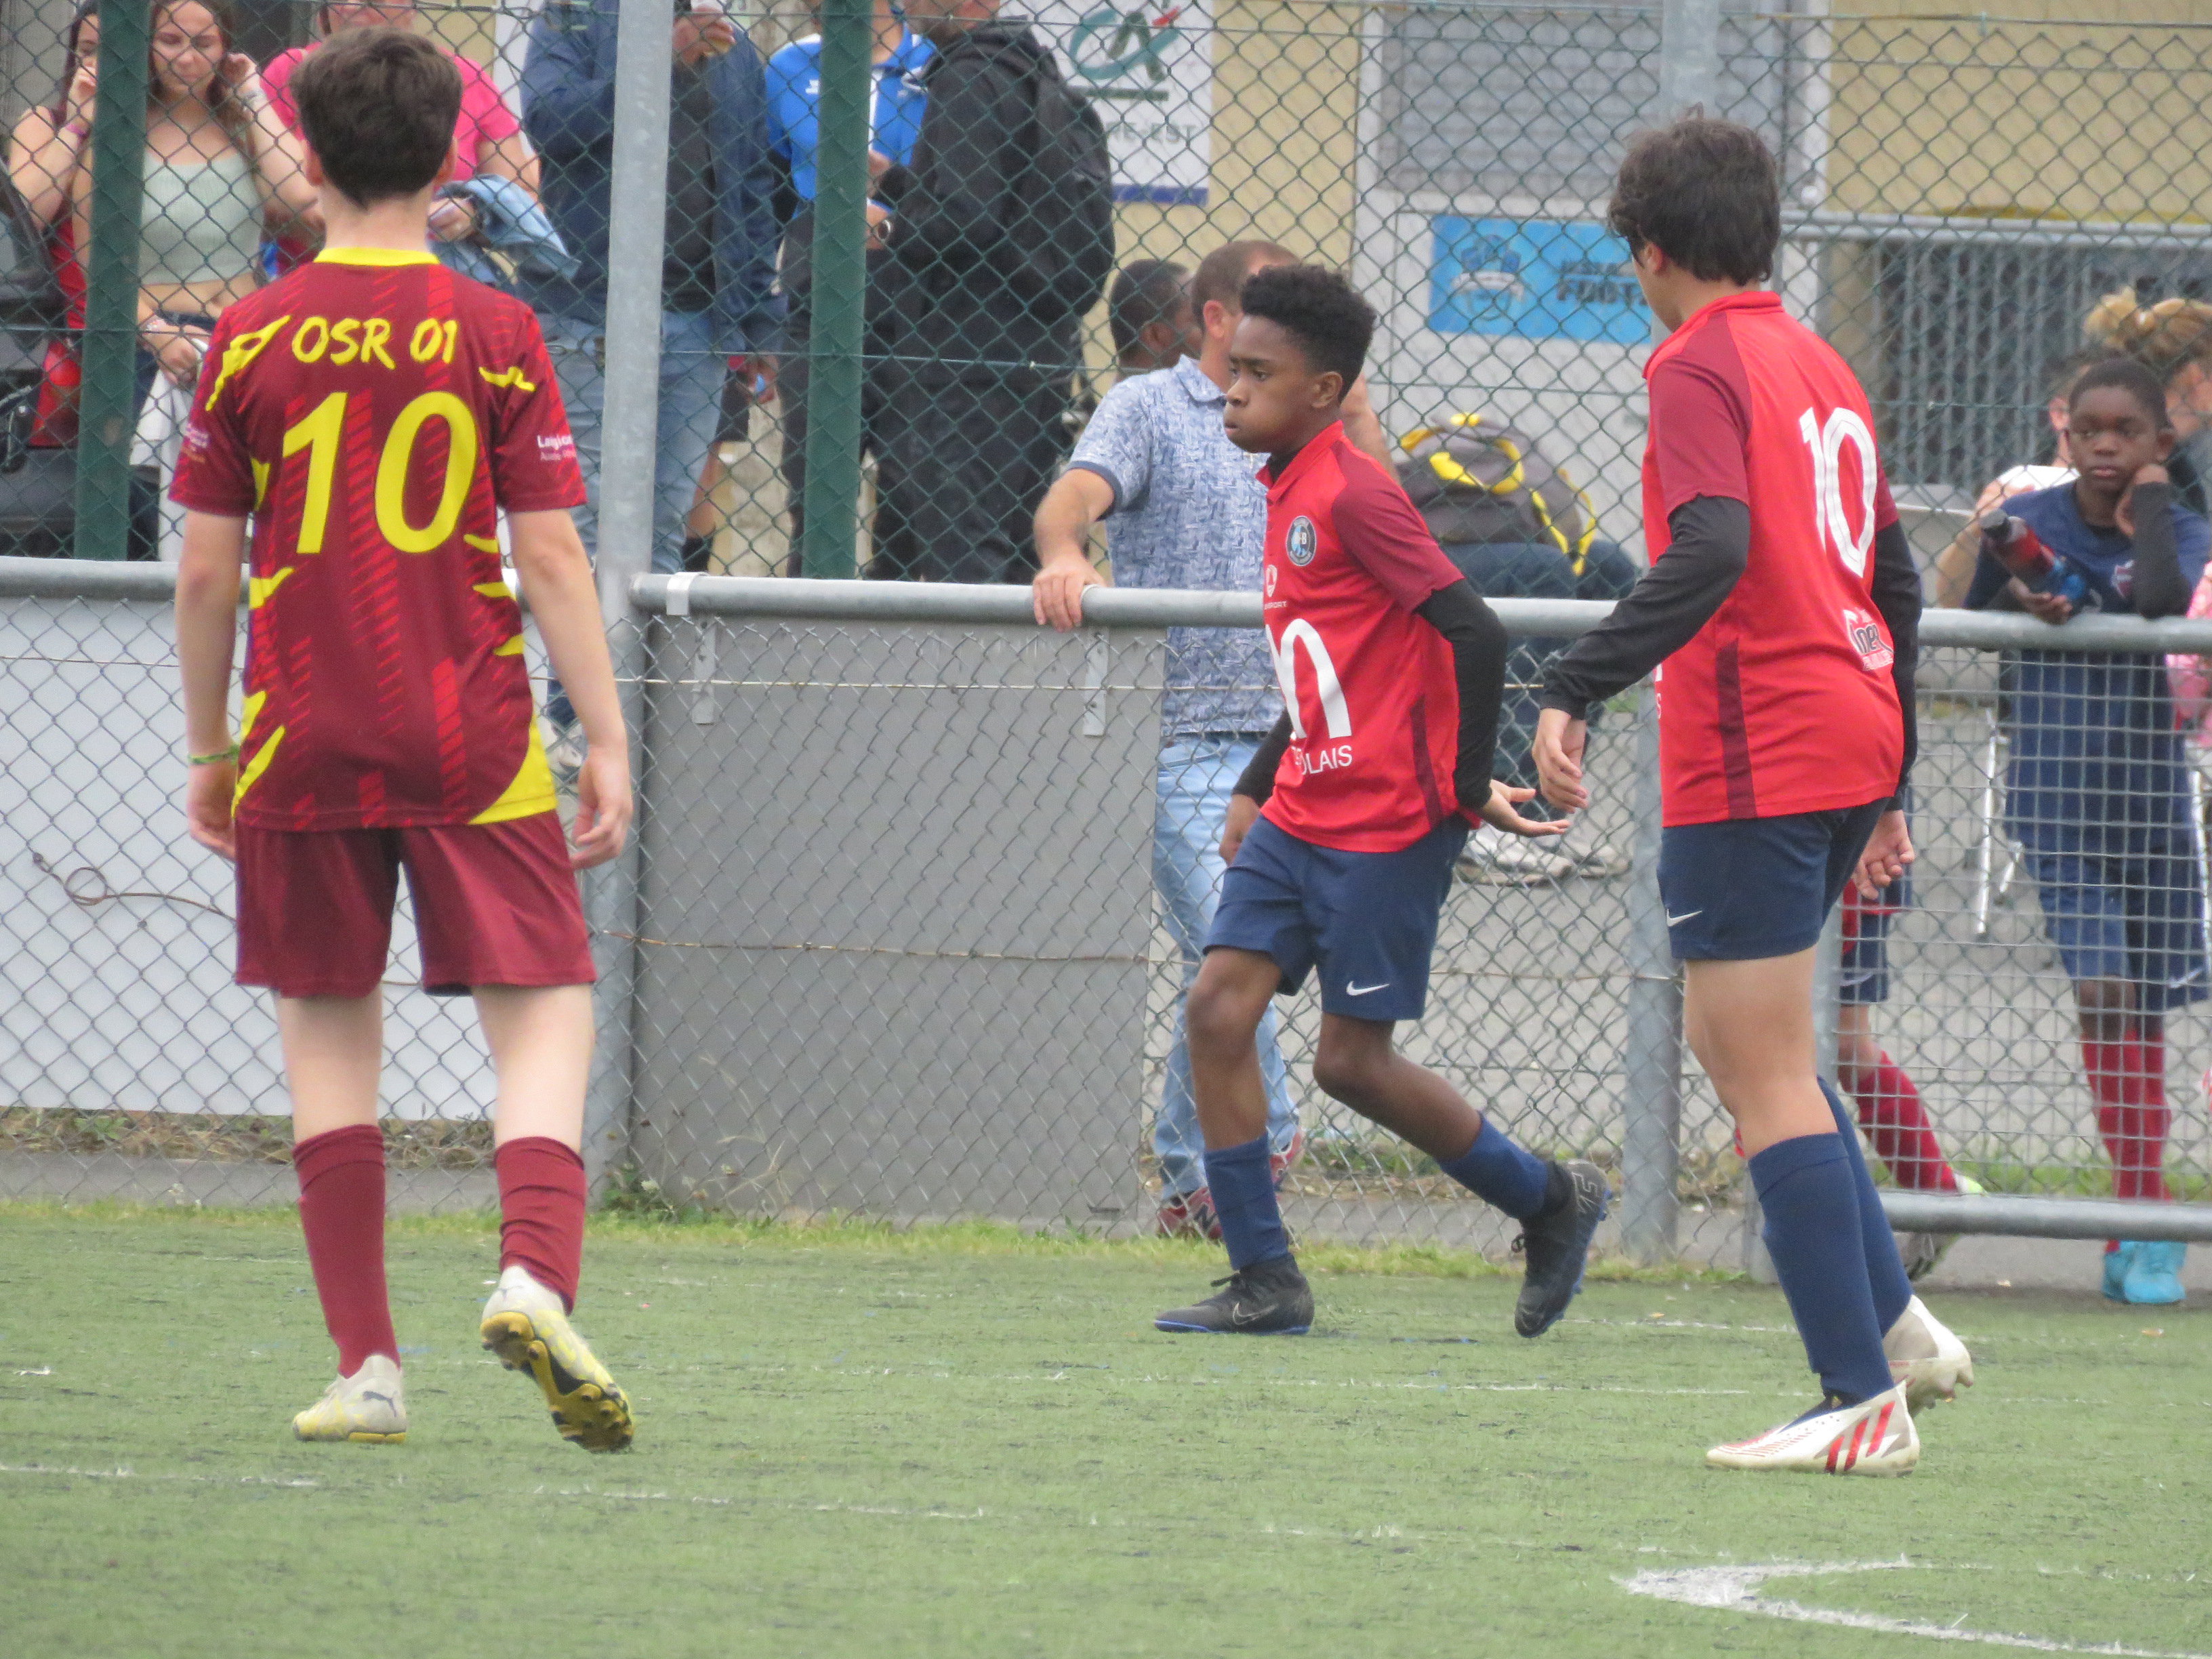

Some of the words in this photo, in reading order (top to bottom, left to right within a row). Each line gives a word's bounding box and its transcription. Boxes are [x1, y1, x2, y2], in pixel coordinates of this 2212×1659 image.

[291, 316, 395, 369] OSR
[283, 390, 478, 554] 10
[1799, 407, 1877, 578] 10
